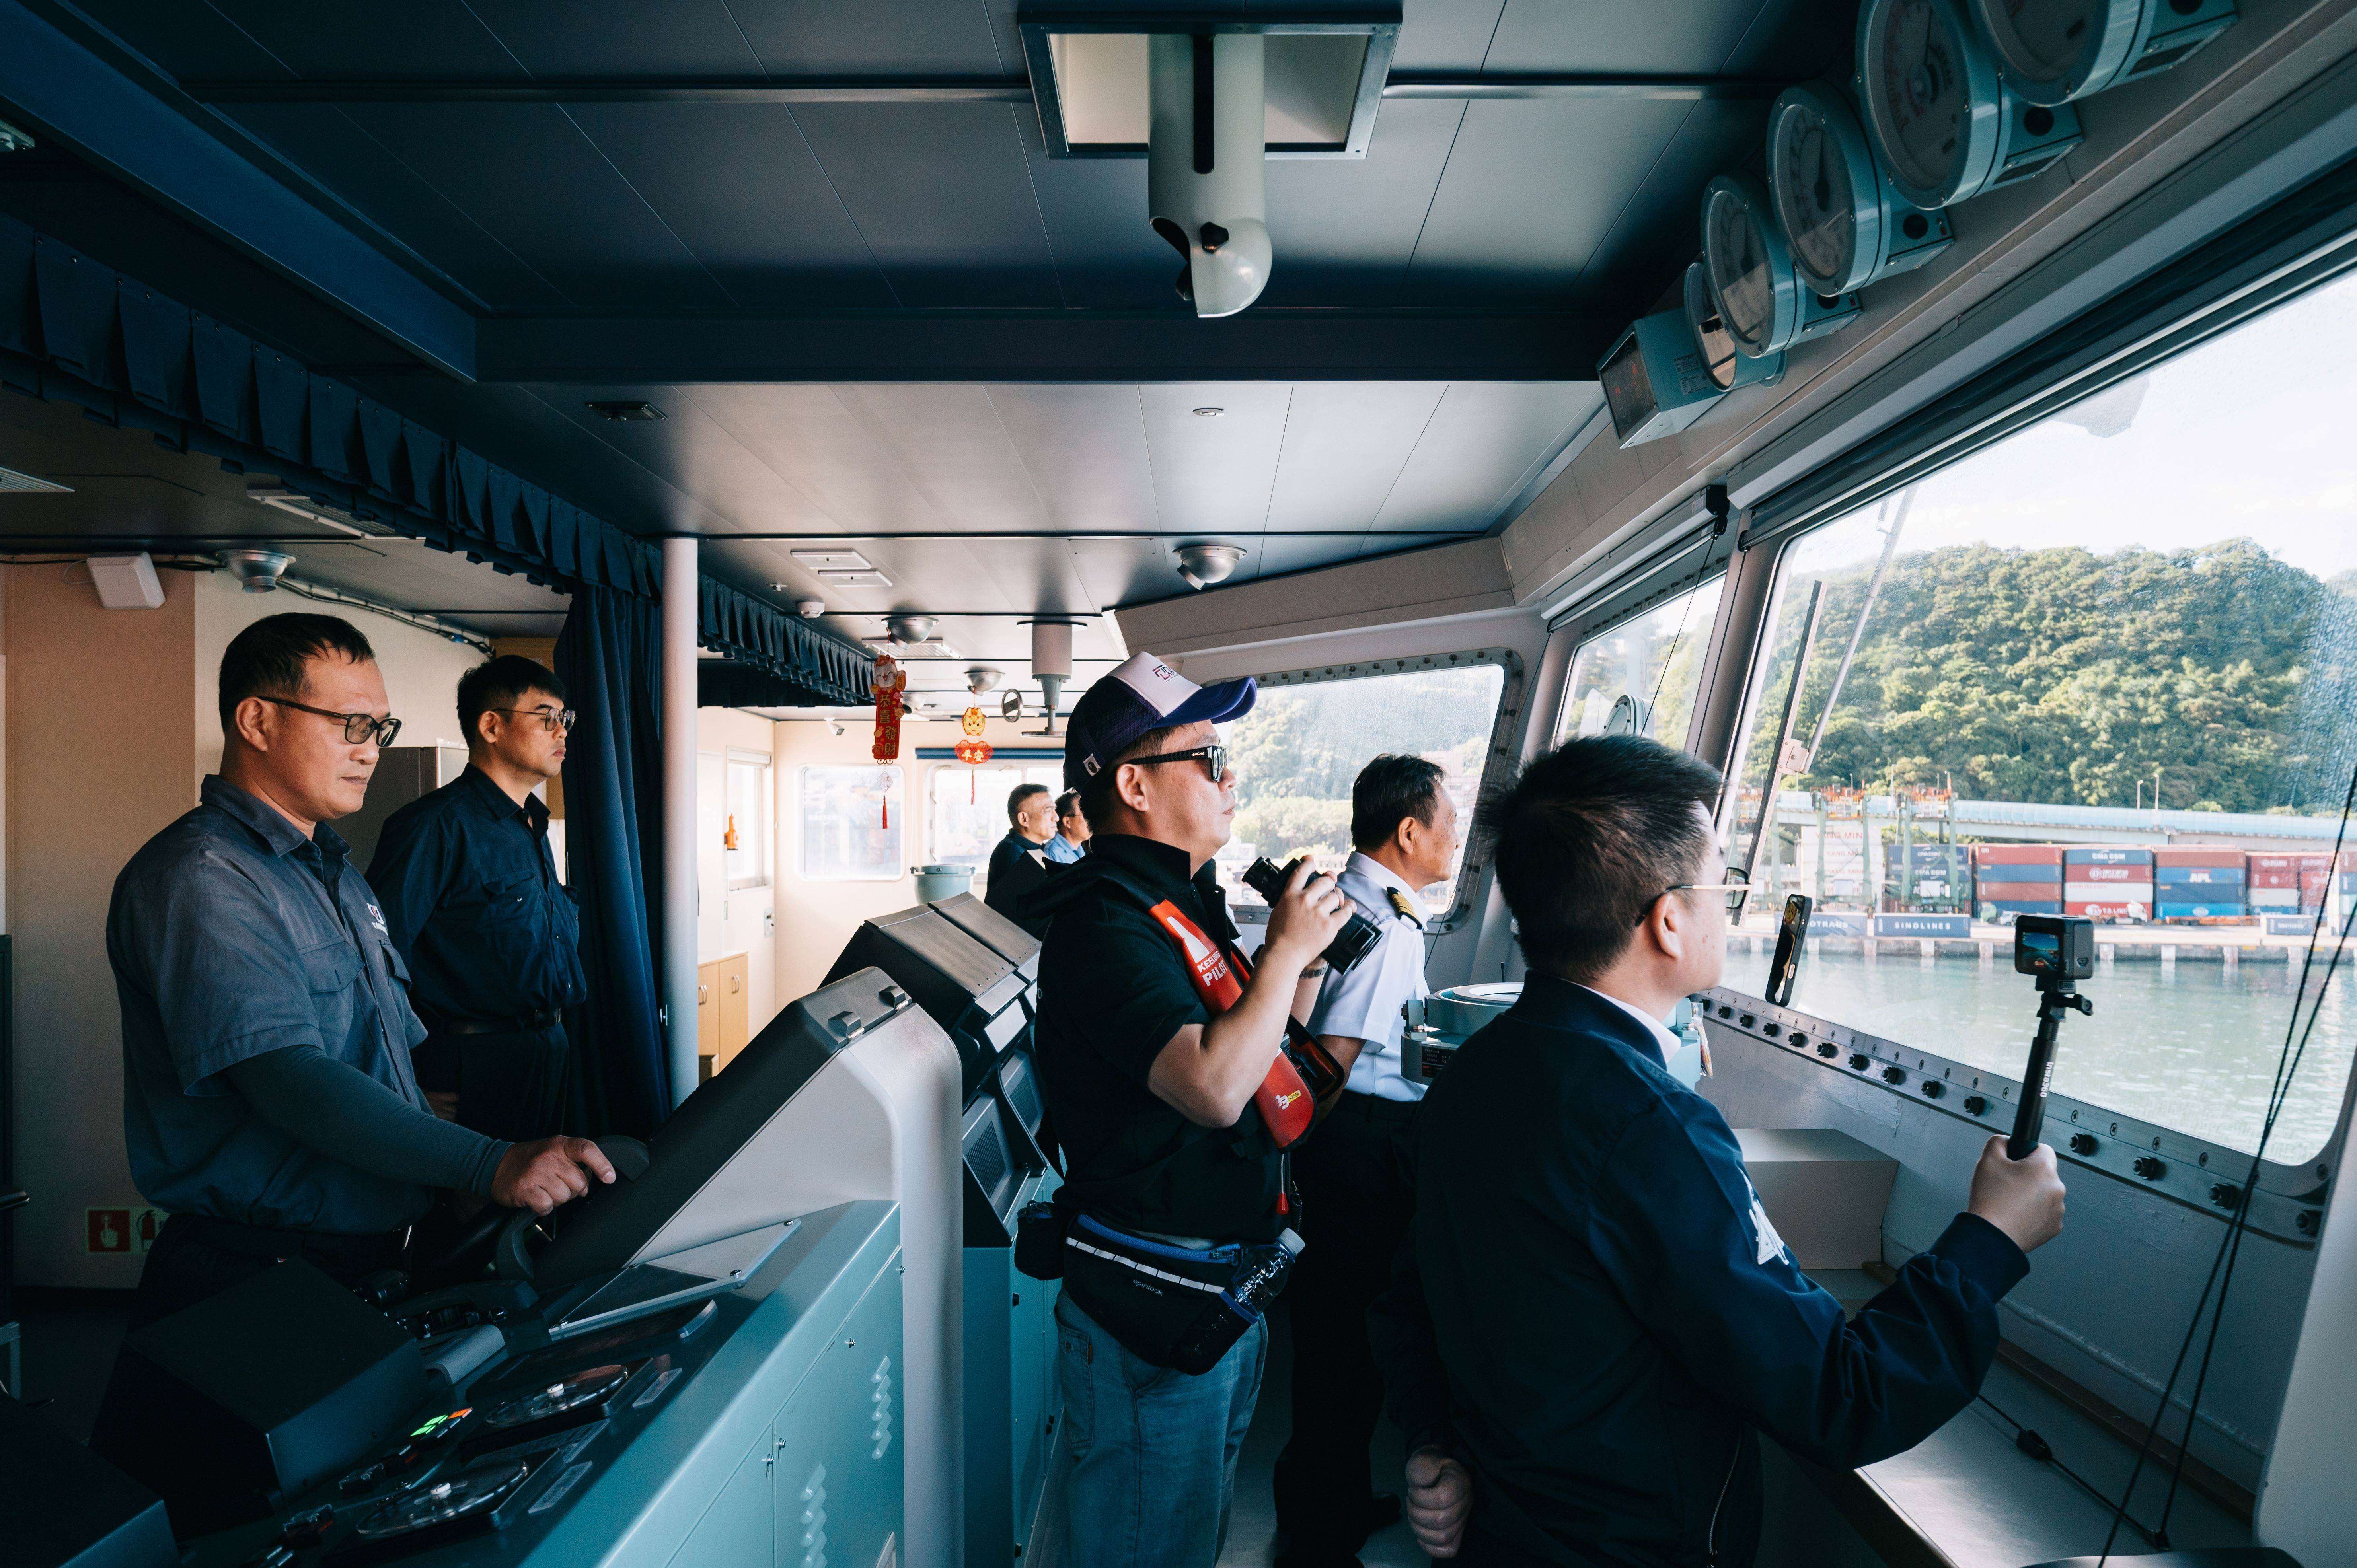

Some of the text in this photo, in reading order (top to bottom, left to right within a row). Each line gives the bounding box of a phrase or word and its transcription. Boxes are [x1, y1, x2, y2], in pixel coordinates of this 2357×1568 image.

[961, 749, 984, 762] 平安
[1895, 922, 1951, 930] SINOLINES
[1197, 950, 1221, 973] KEELUNG
[1202, 959, 1228, 986] PILOT
[1132, 1279, 1163, 1296] spinlock
